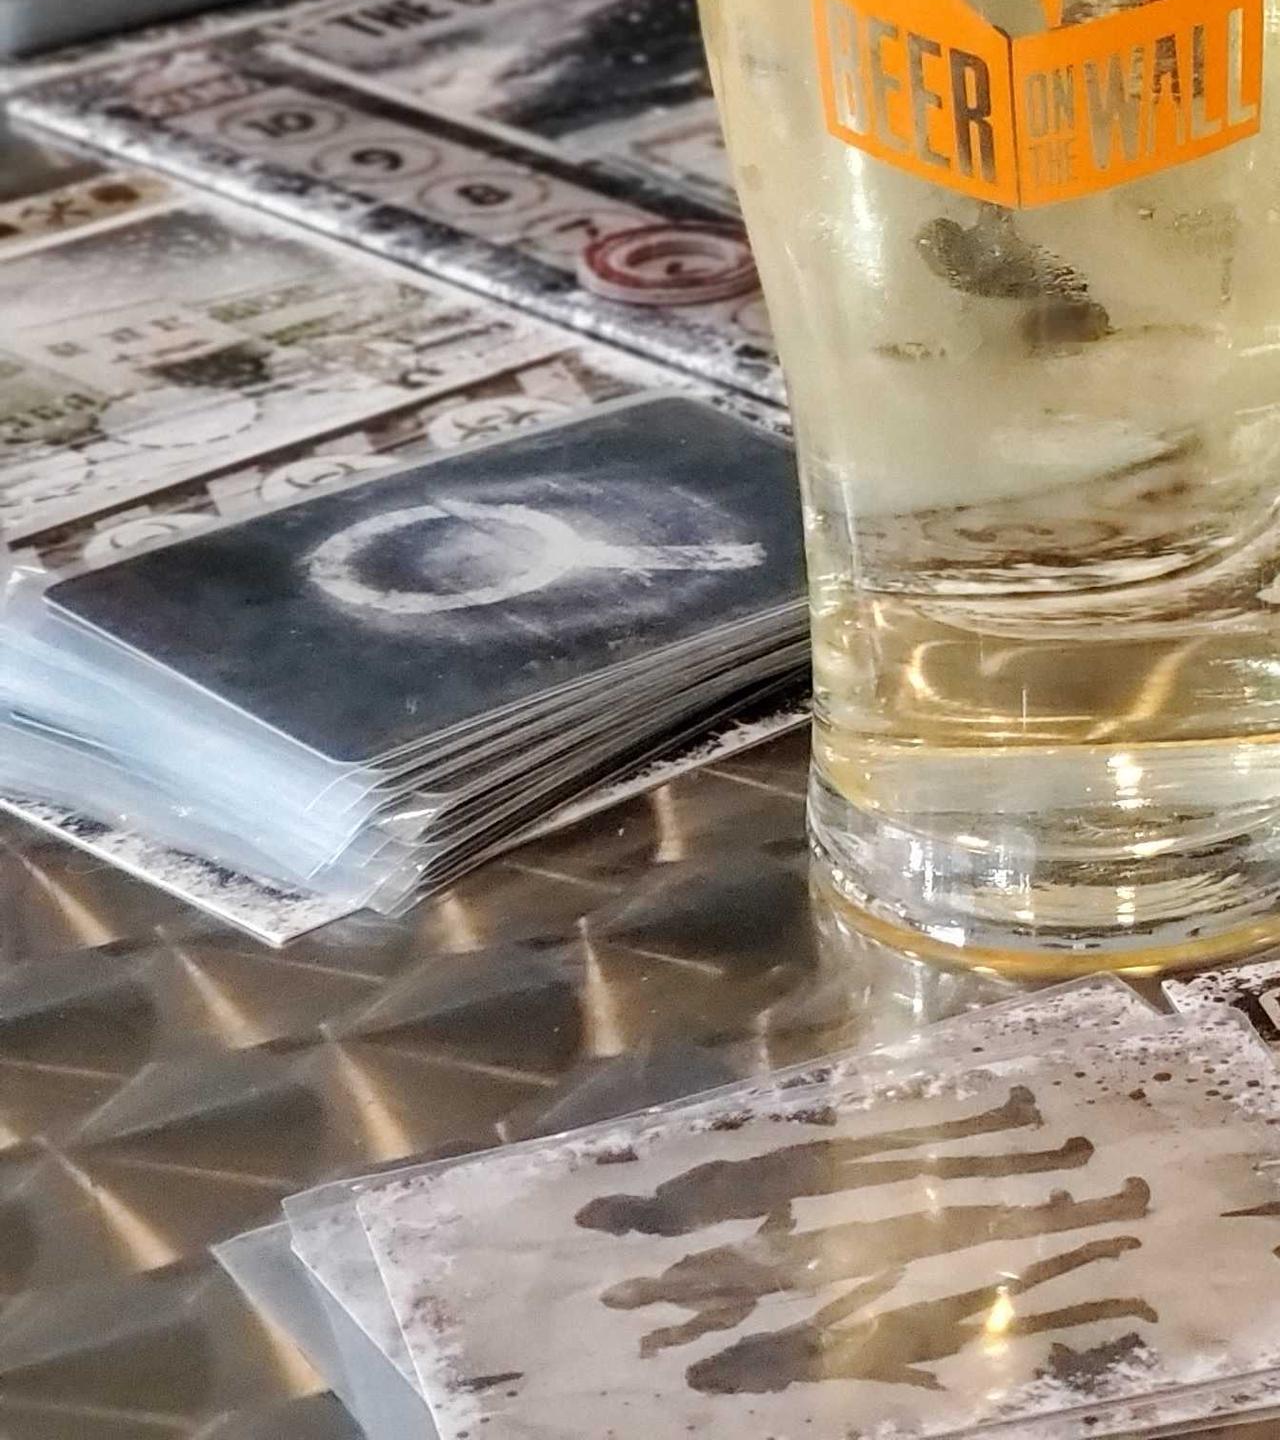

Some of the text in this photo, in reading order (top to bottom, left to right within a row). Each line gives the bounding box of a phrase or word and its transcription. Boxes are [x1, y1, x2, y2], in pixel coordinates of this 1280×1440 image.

[245, 110, 316, 137] 10
[1024, 64, 1075, 137] ON
[1083, 7, 1259, 171] WALL
